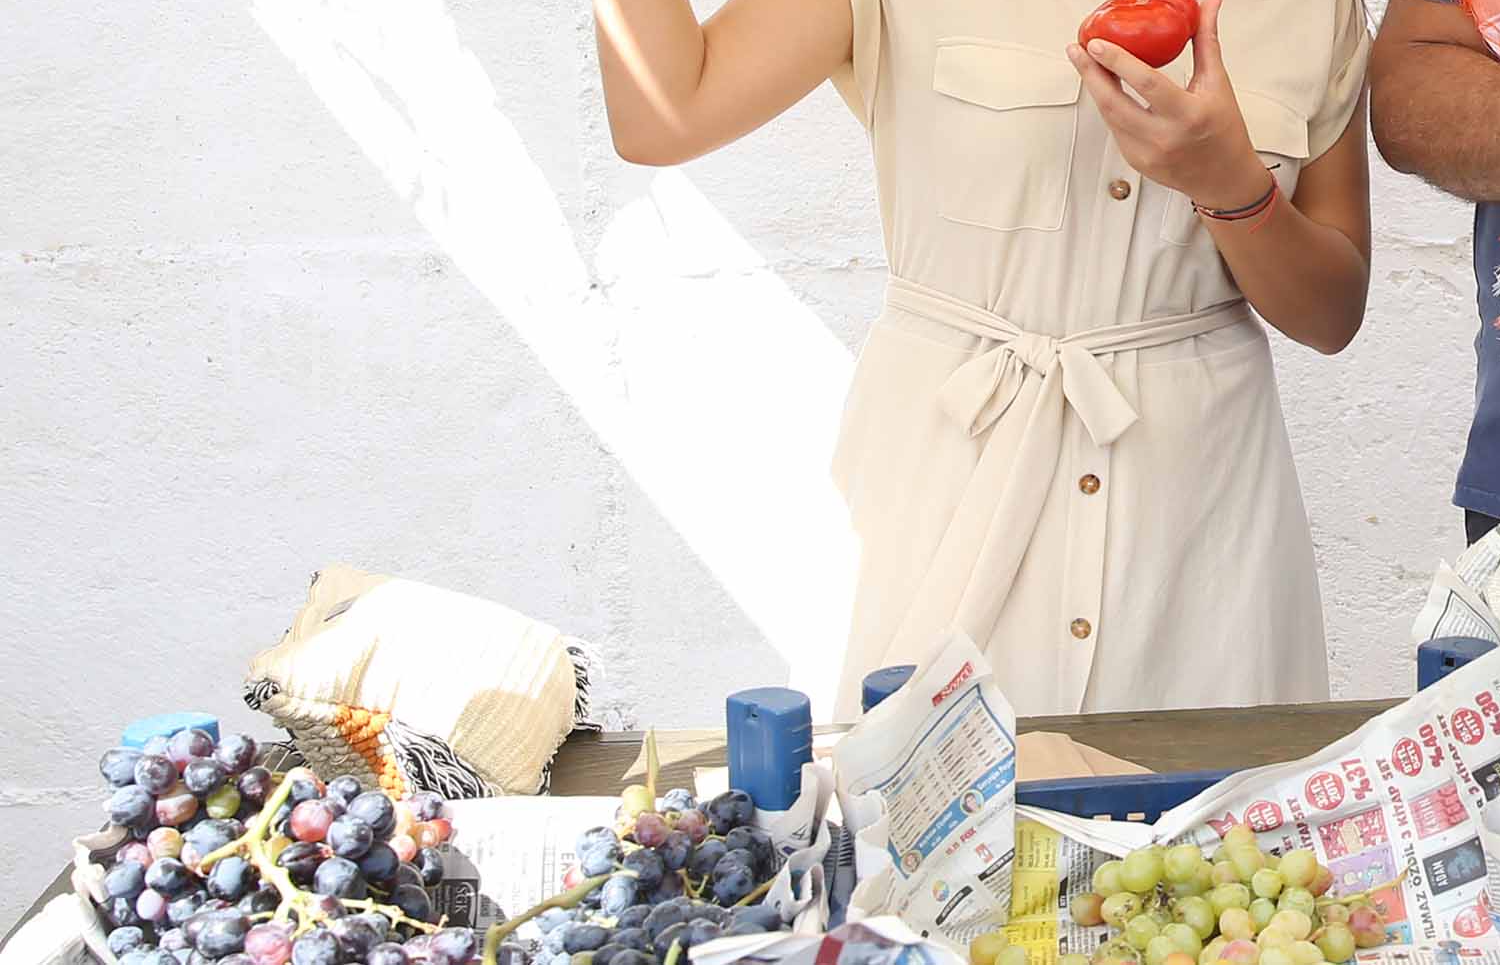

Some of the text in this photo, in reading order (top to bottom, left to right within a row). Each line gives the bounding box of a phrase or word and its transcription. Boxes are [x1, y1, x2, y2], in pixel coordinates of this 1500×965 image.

[1418, 723, 1445, 768] %40
[1340, 757, 1373, 801] %37
[1387, 784, 1409, 828] KİTAP
[1400, 830, 1412, 840] 3
[1403, 842, 1423, 889] ÖZDİL
